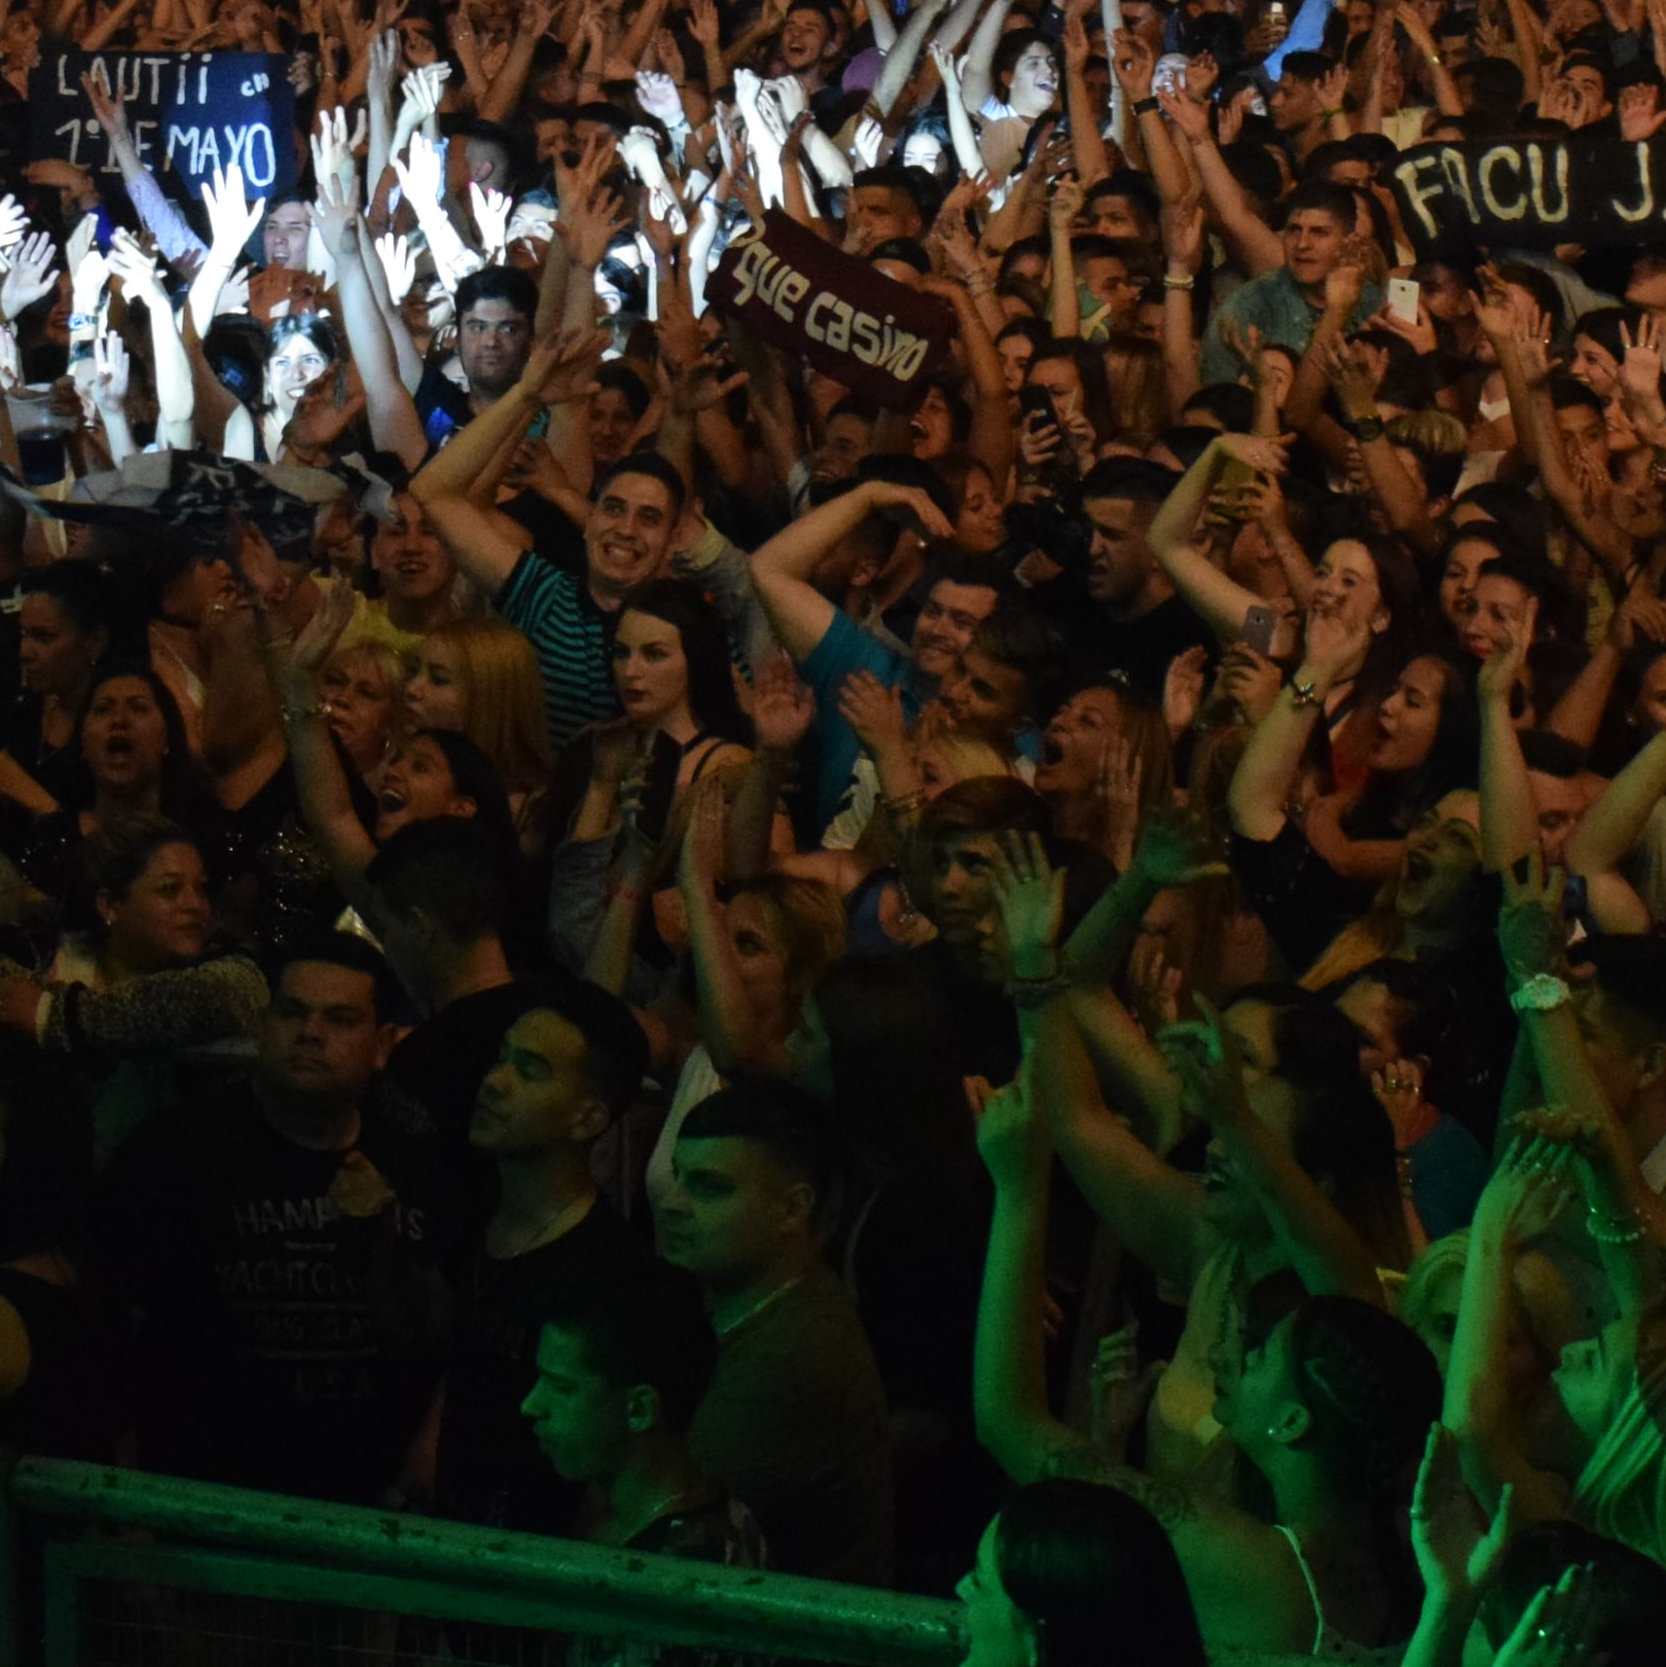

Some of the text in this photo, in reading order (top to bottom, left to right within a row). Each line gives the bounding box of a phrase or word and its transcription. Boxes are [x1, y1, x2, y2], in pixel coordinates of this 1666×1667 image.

[162, 122, 276, 187] MAYO
[1395, 143, 1570, 239] FACU
[732, 241, 930, 382] que casino
